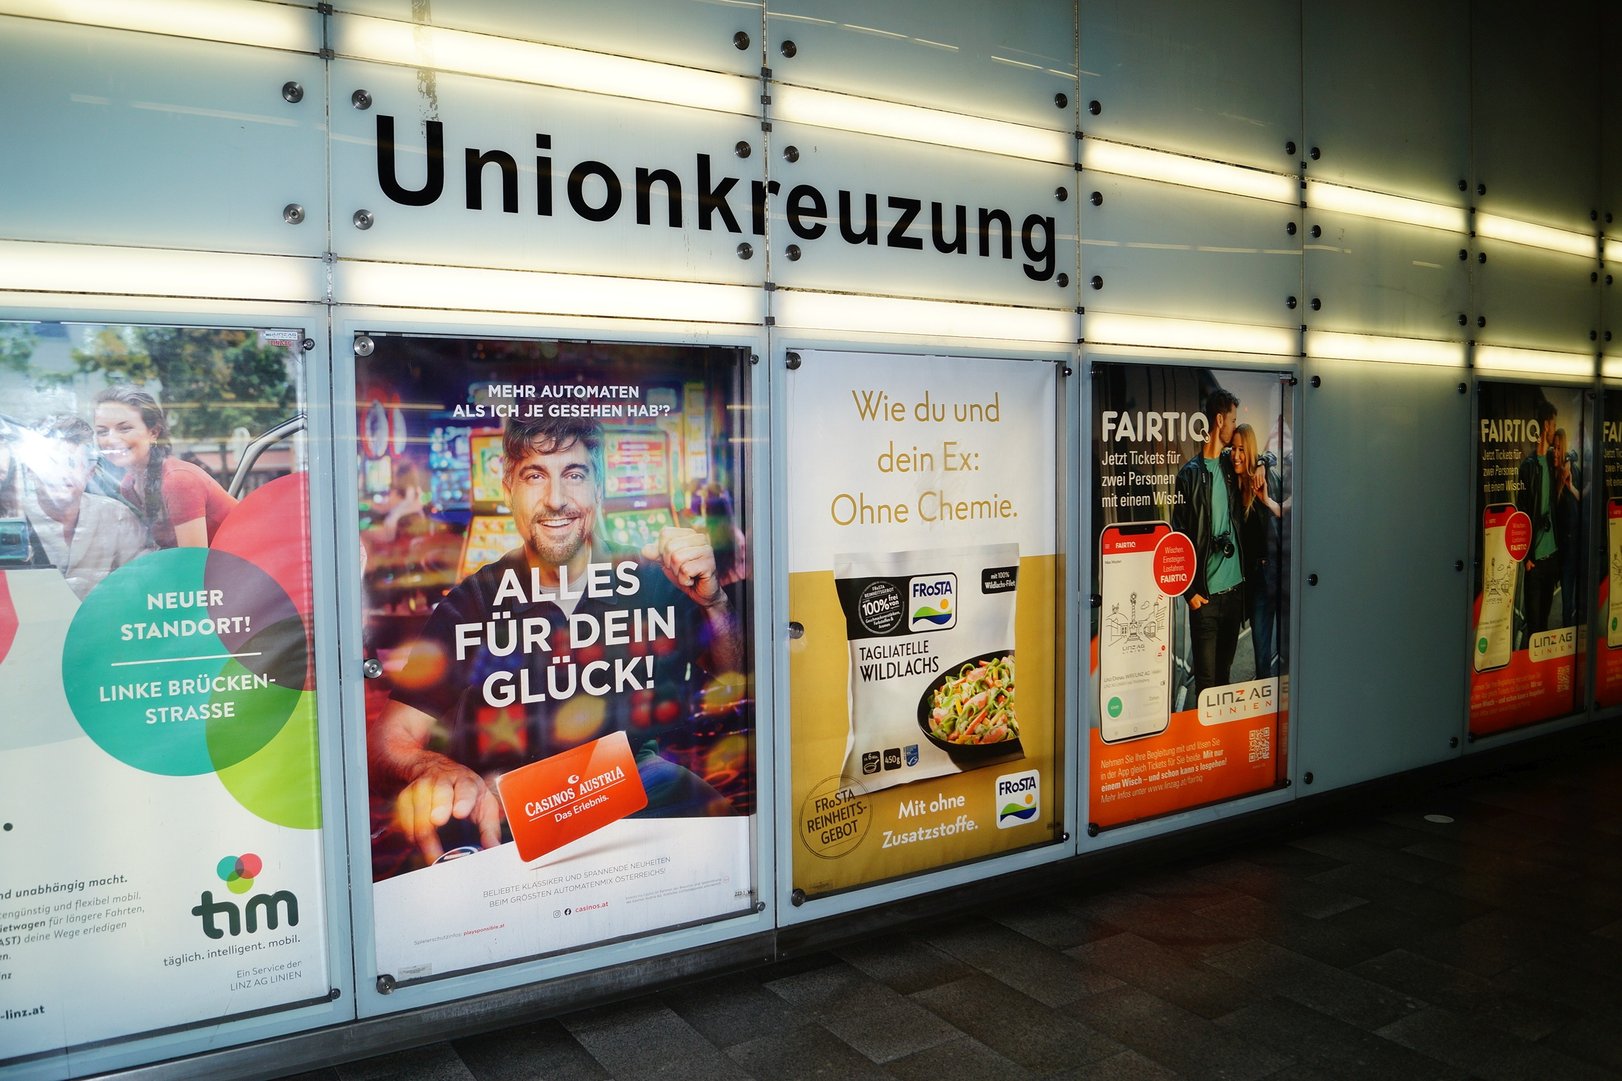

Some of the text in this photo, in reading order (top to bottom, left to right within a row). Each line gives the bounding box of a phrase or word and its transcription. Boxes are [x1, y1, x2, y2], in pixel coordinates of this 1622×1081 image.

[376, 114, 1056, 282] Unionkreuzung
[488, 384, 640, 398] MEHR AUTOMATEN
[452, 404, 486, 418] ALS
[491, 404, 519, 418] ICH
[524, 404, 544, 418] JE
[548, 404, 623, 418] GESEHEN
[852, 390, 1000, 422] Wie du und
[1102, 410, 1211, 444] FAIRTIQ
[1480, 418, 1541, 443] FAIRTIQ
[878, 440, 979, 473] dein Ex:
[1101, 450, 1181, 466] Jetzt Tickets für
[1101, 472, 1176, 487] zwei Personen
[831, 490, 1018, 526] Ohne Chemie.
[1102, 491, 1186, 508] mit einem Wisch.
[492, 561, 640, 606] ALLES
[147, 590, 224, 610] NEUER
[862, 598, 890, 616] 100%
[120, 617, 251, 641] STANDORT!
[455, 606, 676, 660] FÜR DEIN
[859, 640, 930, 662] TAGLIATELLE
[860, 656, 940, 682] WILDLACHS
[100, 674, 276, 702] LINKE BRÜCKEN-
[482, 655, 655, 708] GLÜCK!
[1206, 690, 1246, 708] LINZ
[1249, 685, 1272, 700] AG
[146, 702, 235, 724] STRASSE
[1206, 700, 1272, 718] LINIEN
[885, 755, 900, 765] 450g
[524, 766, 625, 817] CASINOS AUSTRIA
[999, 776, 1036, 796] FRoSTA
[1121, 776, 1142, 787] Wisch
[1149, 772, 1160, 782] und
[554, 794, 609, 822] Das Erlebnis.
[898, 793, 965, 820] Mit ohne
[807, 804, 868, 834] REINHEITS-
[821, 820, 858, 845] GEBOT
[882, 815, 978, 848] Zusatzstoffe.
[16, 880, 85, 898] unabhängig
[89, 875, 128, 887] macht.
[483, 856, 671, 898] BELIEBTE KLASSIKER UND SPANNENDE NEUHEITEN
[489, 898, 509, 908] BEIM
[554, 878, 613, 898] AUTOMATENMIX
[0, 906, 51, 919] engünstig
[54, 902, 72, 912] und
[75, 896, 110, 910] flexibel
[48, 917, 62, 928] für
[66, 913, 102, 924] längere
[105, 905, 145, 917] Fahrten,
[191, 890, 299, 939] tim
[575, 901, 609, 913] casinos.at
[24, 932, 51, 943] deine
[54, 929, 80, 939] Wege
[83, 921, 127, 935] erledigen
[164, 934, 301, 967] täglich. intelligent. mobil.
[230, 971, 302, 991] LINZ AG LINIEN
[236, 960, 302, 978] Ein Service der
